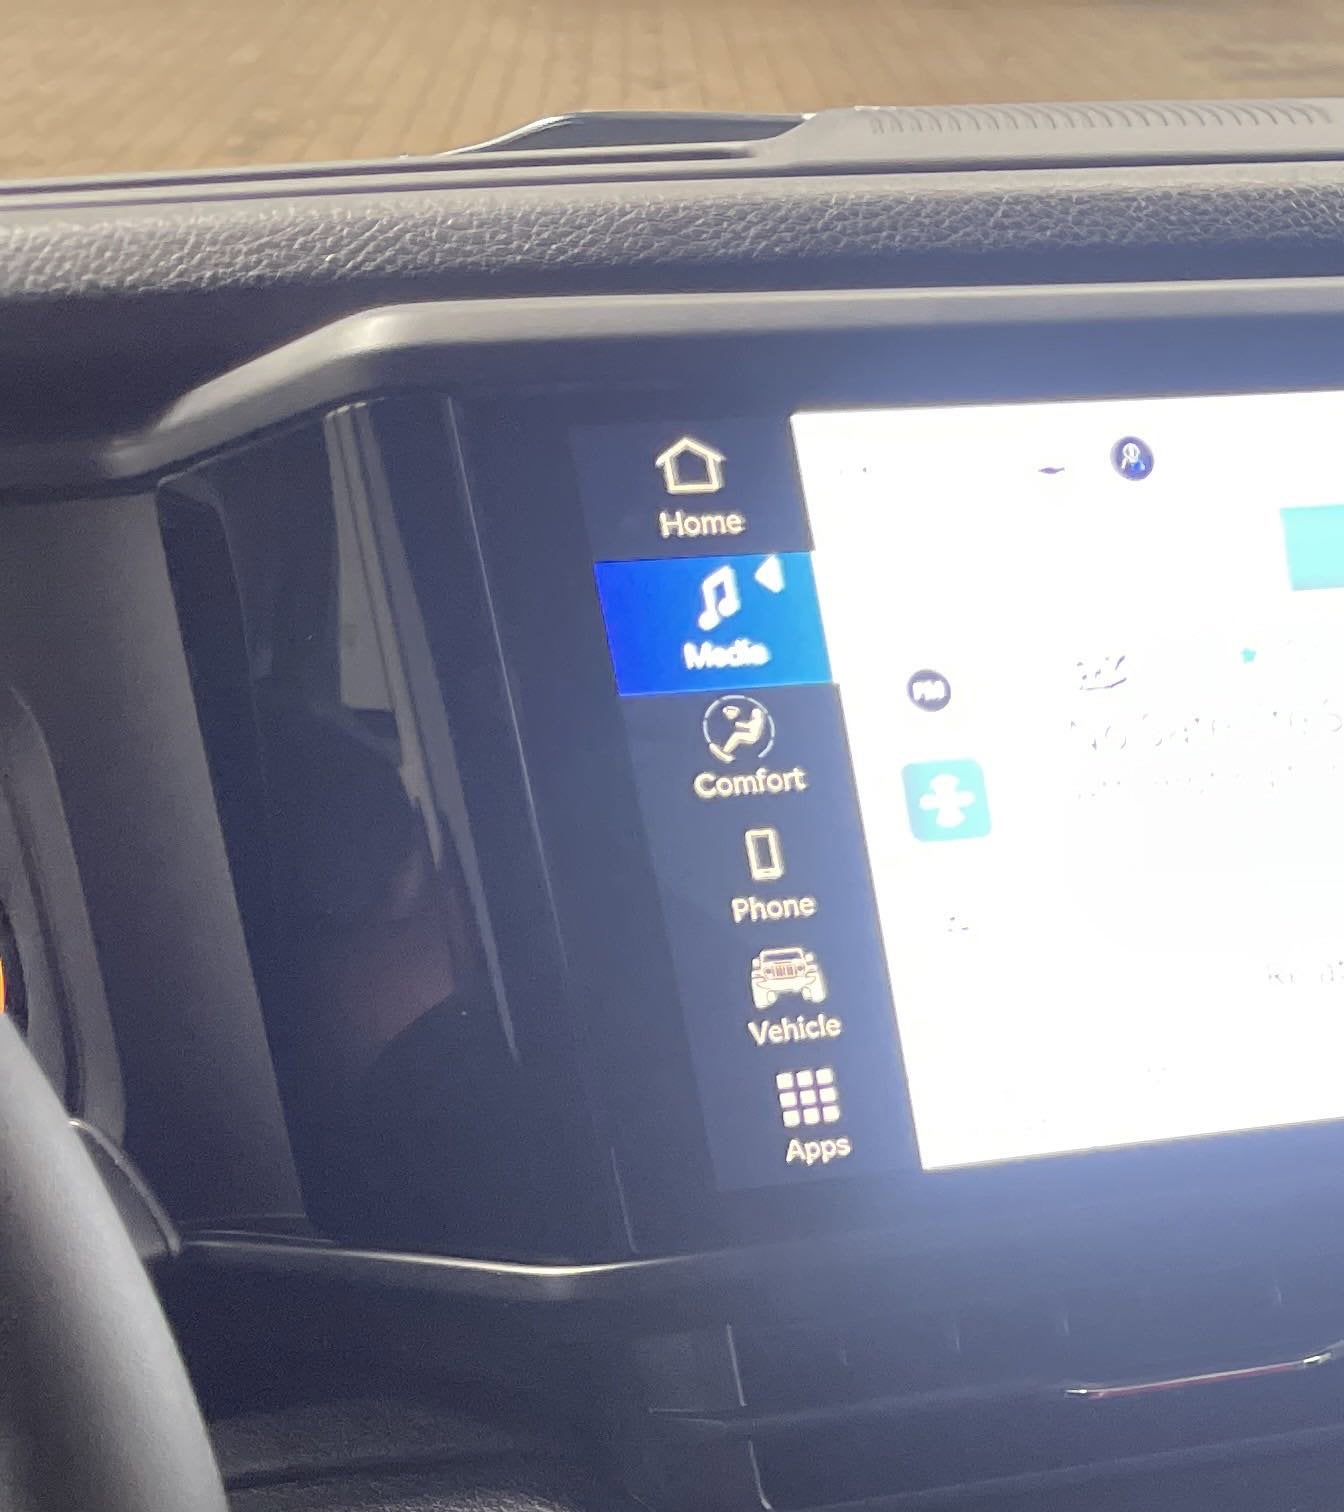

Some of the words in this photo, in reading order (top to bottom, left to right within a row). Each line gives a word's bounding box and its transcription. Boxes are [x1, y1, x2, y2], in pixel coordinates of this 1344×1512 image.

[658, 510, 745, 538] Home
[683, 639, 772, 670] Media
[694, 768, 807, 798] Comfort
[732, 896, 817, 922] Phone
[748, 1014, 842, 1046] Vehicle
[786, 1136, 851, 1166] Apps
